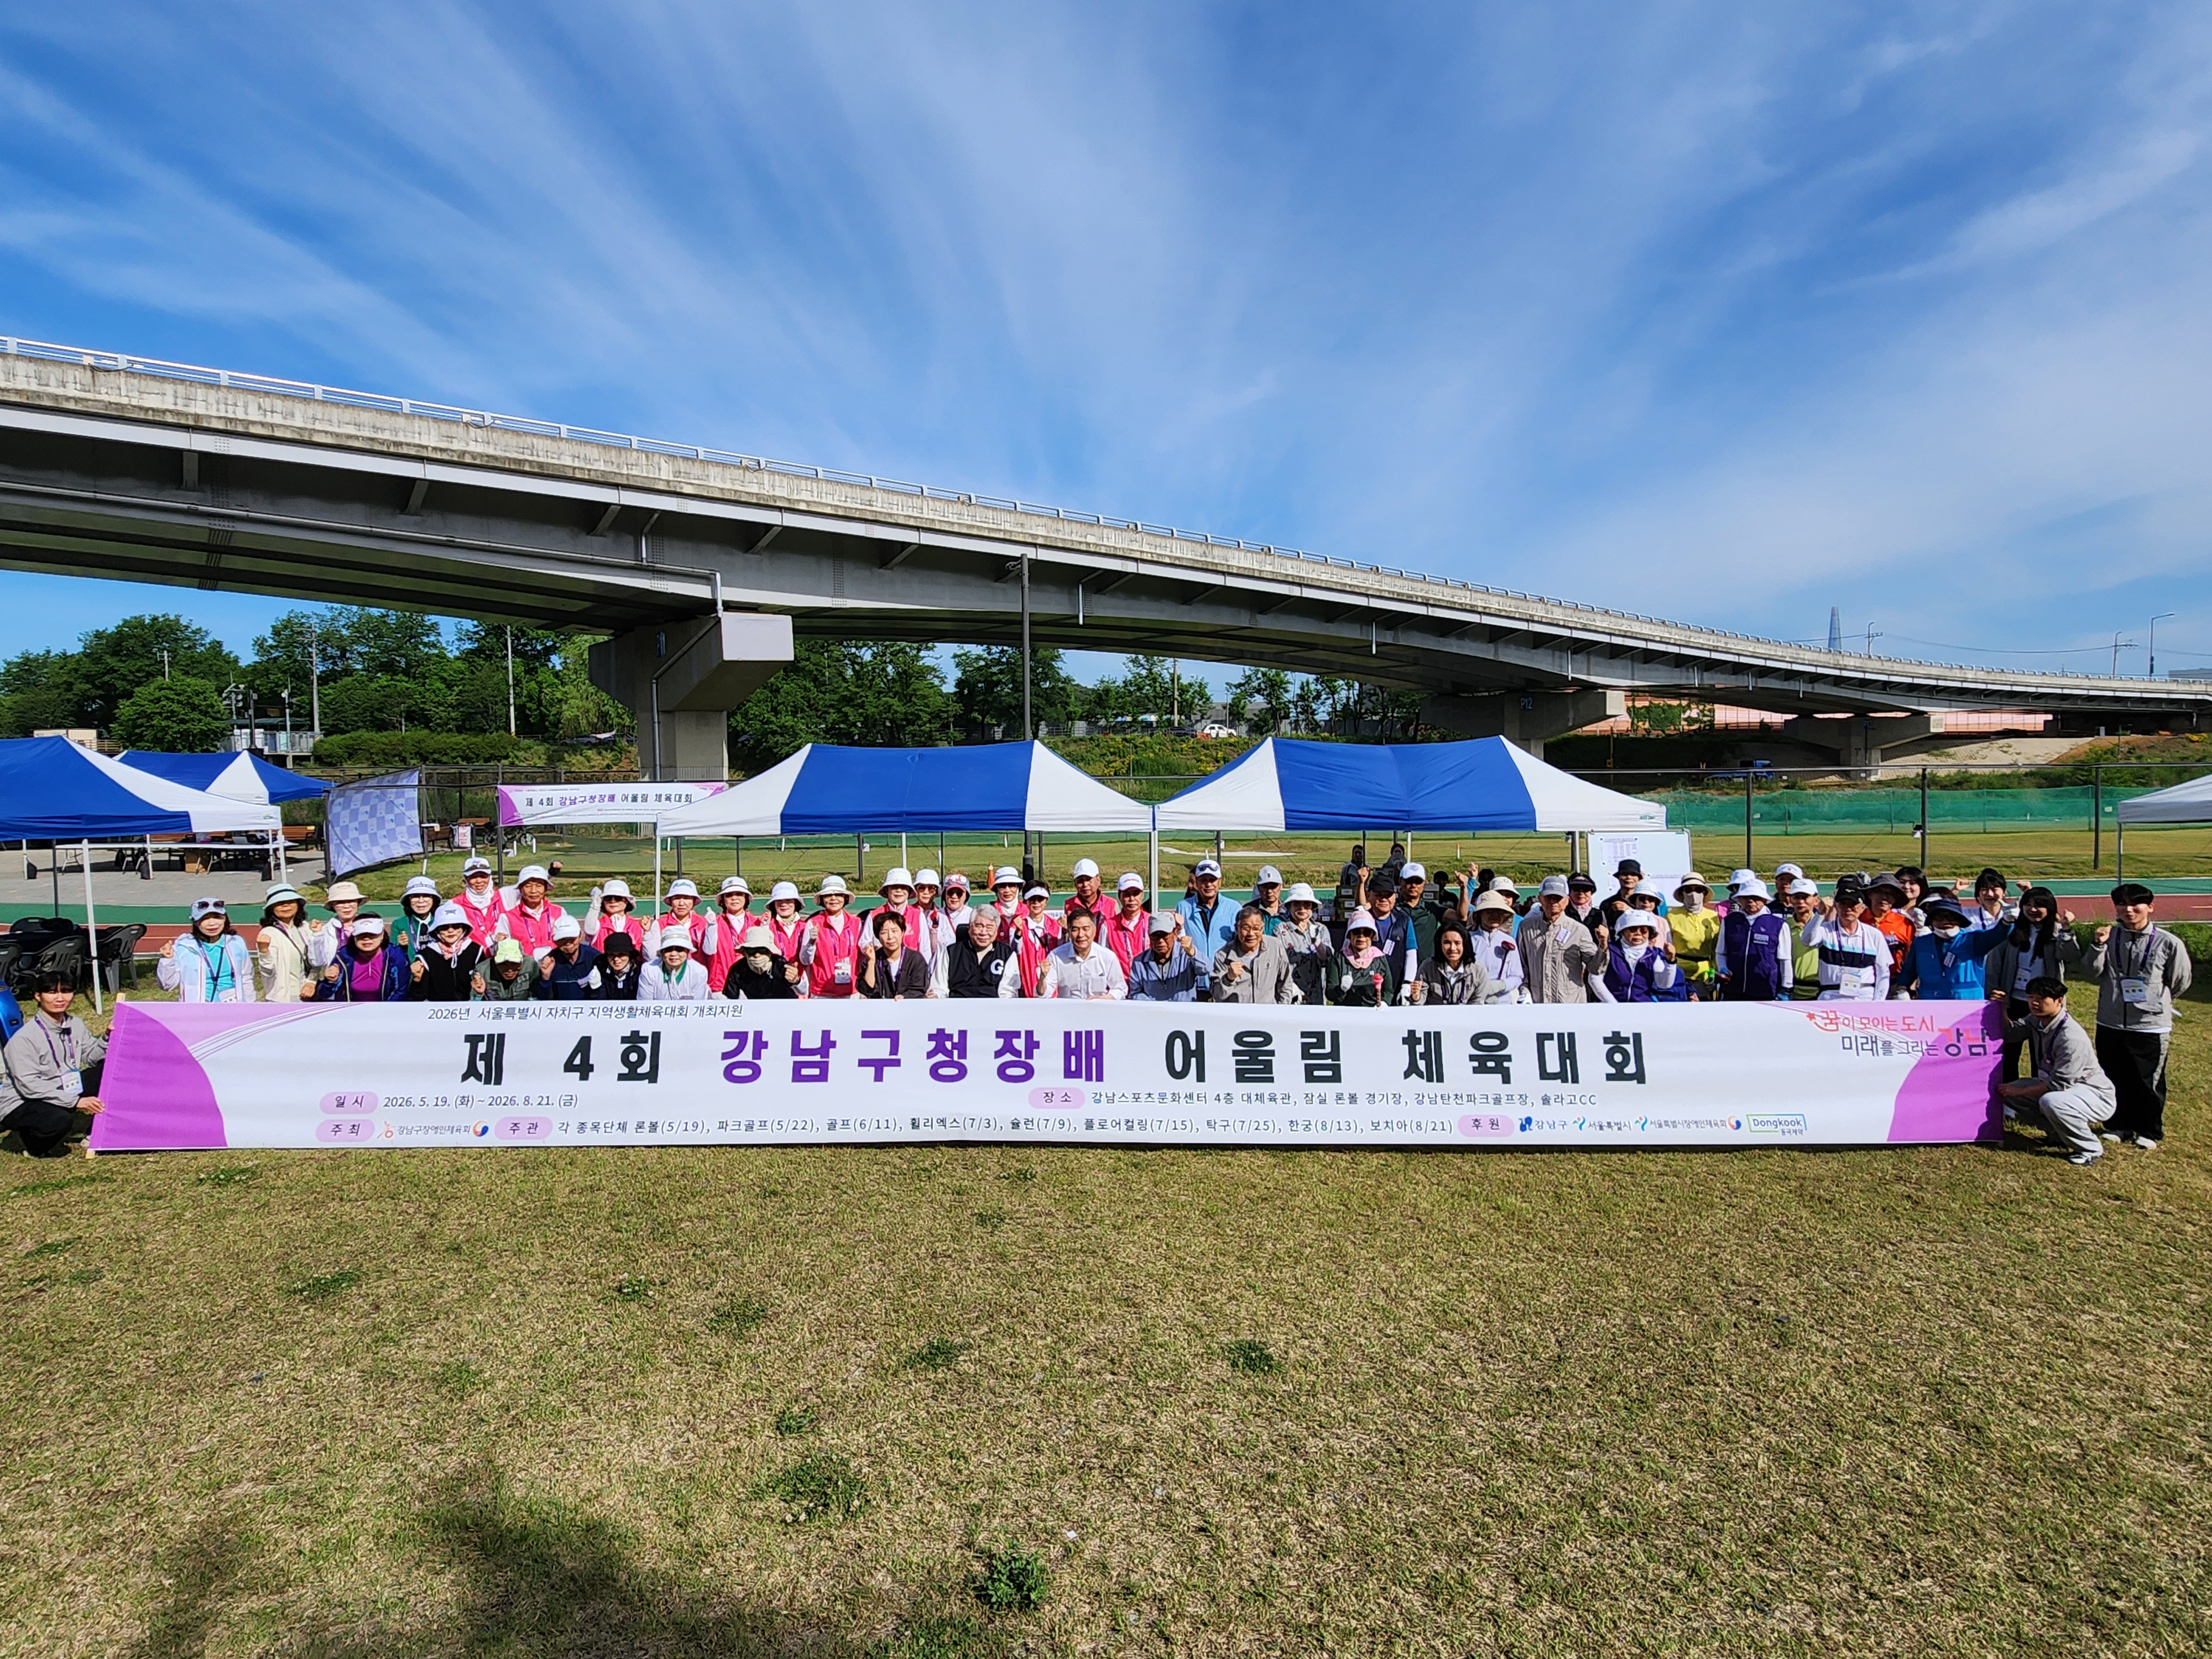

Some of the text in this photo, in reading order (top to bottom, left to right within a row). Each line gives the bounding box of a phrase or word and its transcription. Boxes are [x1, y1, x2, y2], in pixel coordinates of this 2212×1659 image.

[1521, 697, 1533, 709] P12
[525, 793, 692, 807] 제 4회 강남구청장배 어울림 체육대회
[990, 959, 1004, 975] G
[427, 1004, 743, 1020] 2026년 서울특별시 자치구 지역생활체육대회 개최지원
[1818, 1010, 1934, 1032] 꿈이 모이는 도시
[1841, 1027, 1989, 1057] 미래를 그리는 강남
[460, 1027, 1646, 1086] 제 4회 강남구청장배 어울림 체육대회
[383, 1097, 415, 1107] 2026.
[419, 1097, 430, 1107] 5.
[433, 1097, 451, 1107] 19.
[455, 1095, 474, 1109] (화)
[488, 1095, 519, 1107] 2026.
[523, 1095, 534, 1107] 8.
[536, 1095, 555, 1106] 21.
[558, 1094, 578, 1108] (금)
[1092, 1092, 1597, 1107] 강남스포츠문화센터 4층 대체육관, 잠실 론볼 경기장, 강남탄천파크골프장, 솔라고CC
[397, 1125, 471, 1135] 강남구장애인체육회
[557, 1117, 1452, 1134] 각 종목단체 론볼(5/19), 파크골프(5/22), 골프(6/11), 휠리엑스(7/3), 슐런(7/9), 플로어컬링(7/15), 탁구(7/25), 한궁(8/13), 보치아(8/21)
[1535, 1120, 1568, 1130] 강남구
[1588, 1120, 1632, 1131] 서울특별시
[1752, 1118, 1802, 1129] Dongkook
